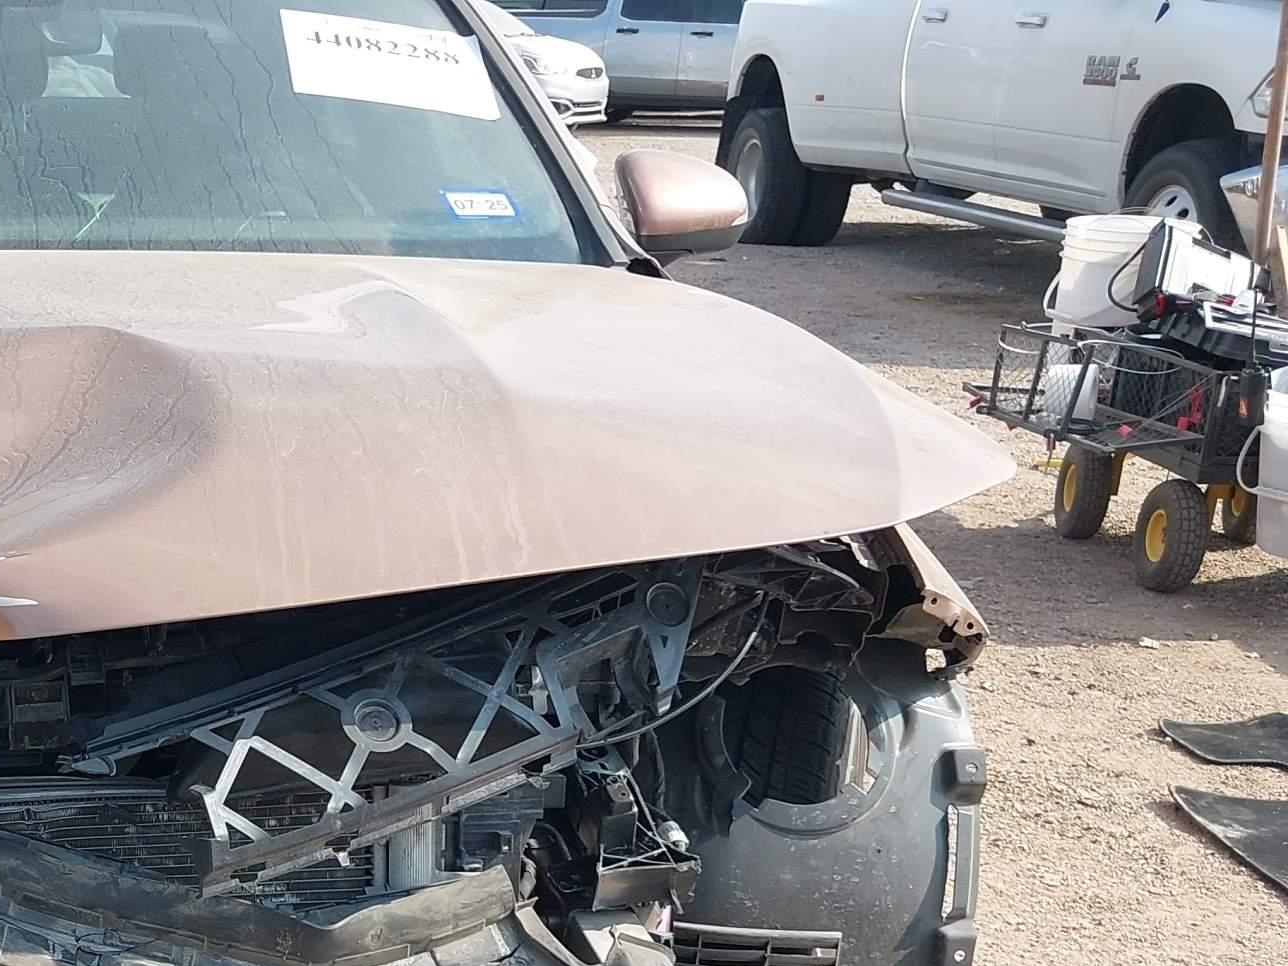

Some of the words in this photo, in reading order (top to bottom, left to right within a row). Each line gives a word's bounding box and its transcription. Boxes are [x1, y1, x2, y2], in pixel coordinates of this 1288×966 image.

[306, 31, 461, 65] 44082288
[1086, 55, 1121, 67] RAM
[453, 199, 474, 210] 07
[484, 199, 508, 210] 25
